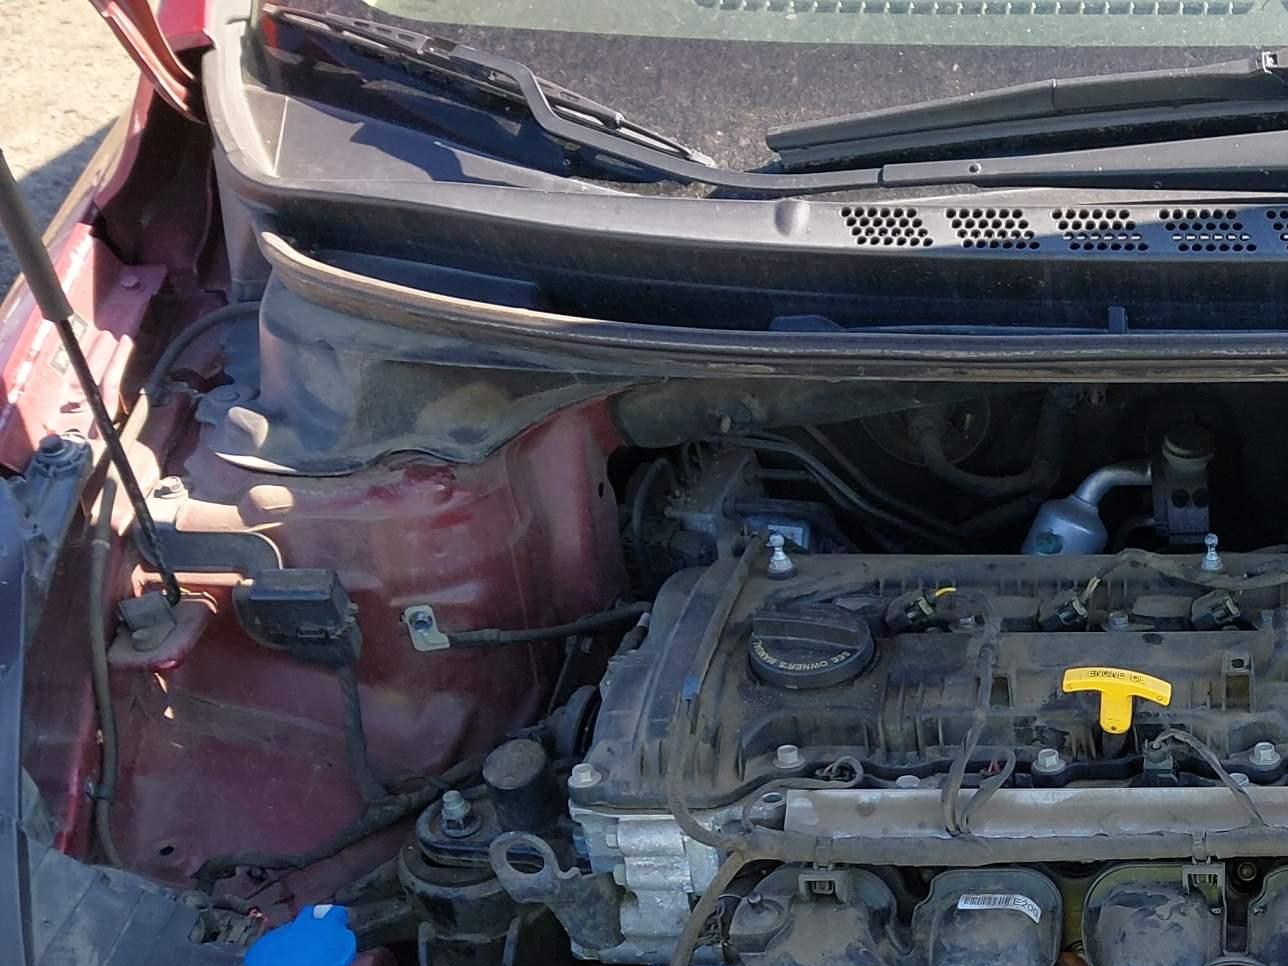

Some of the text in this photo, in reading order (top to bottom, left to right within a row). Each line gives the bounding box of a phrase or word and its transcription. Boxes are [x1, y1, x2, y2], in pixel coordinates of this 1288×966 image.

[830, 650, 851, 664] SEE
[778, 660, 828, 671] OWNER'S
[1088, 669, 1126, 680] ENGINE
